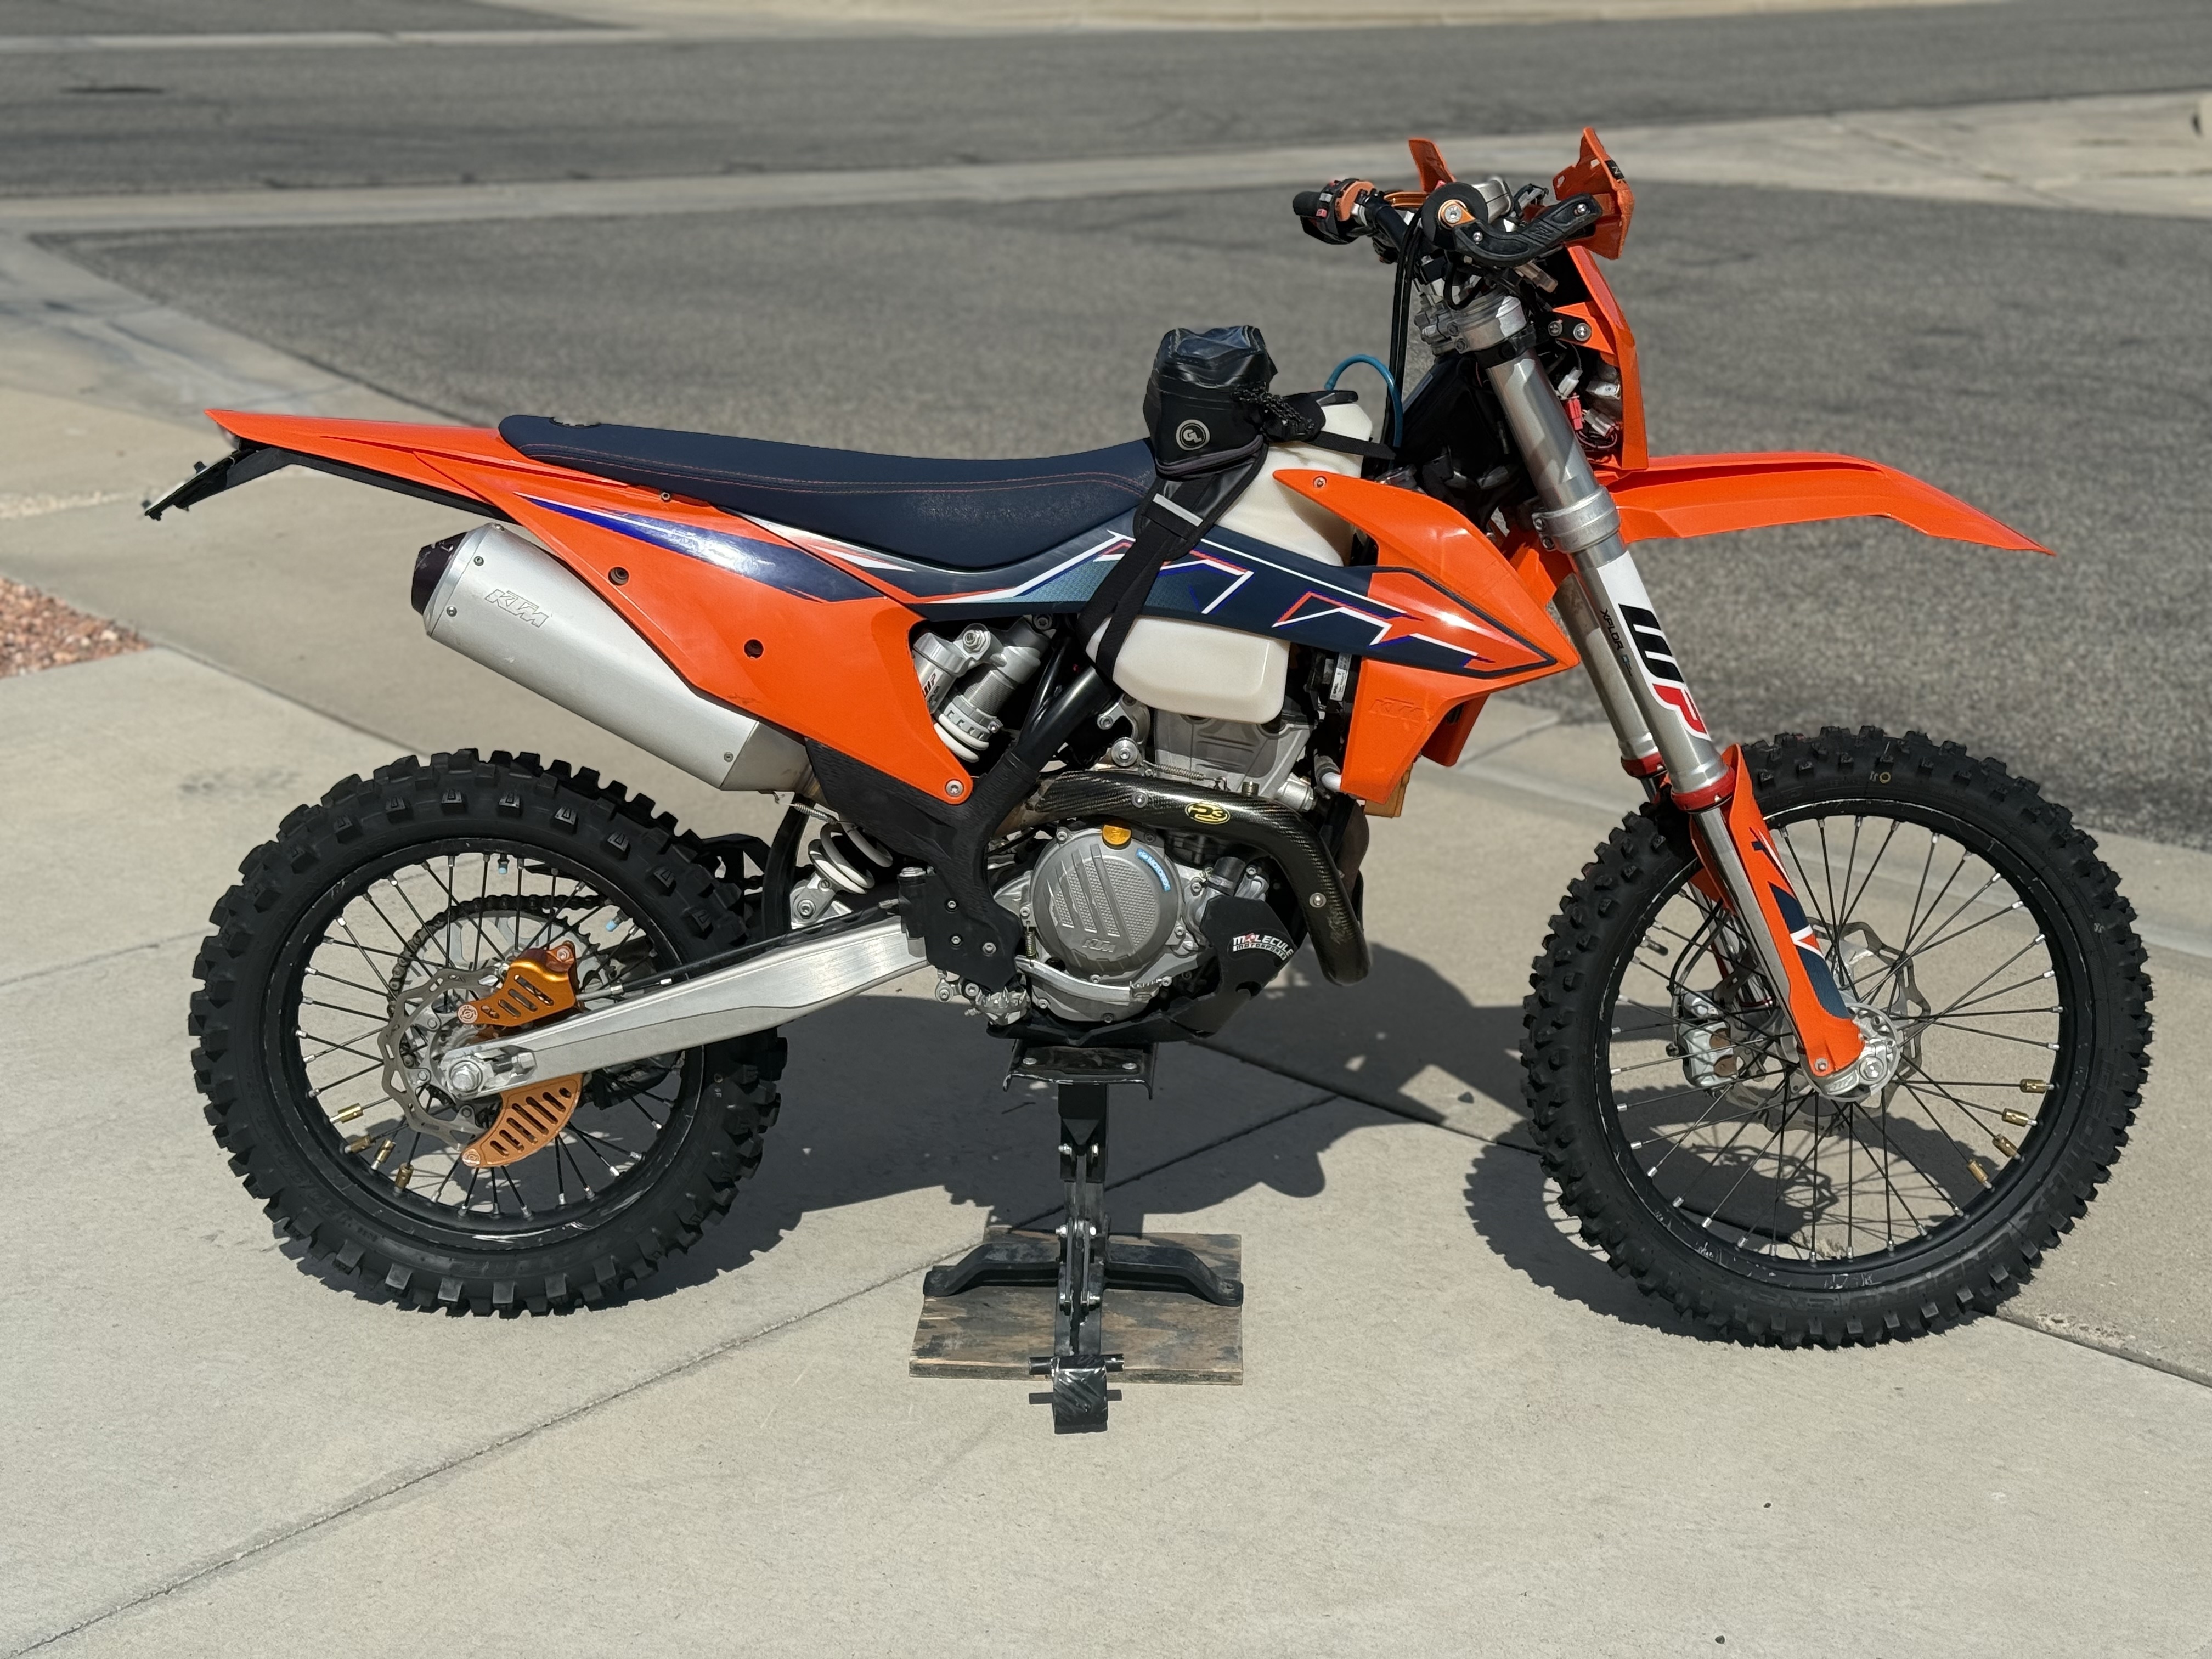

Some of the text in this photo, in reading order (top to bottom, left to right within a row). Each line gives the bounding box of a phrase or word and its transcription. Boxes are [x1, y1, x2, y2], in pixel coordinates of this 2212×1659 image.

[484, 589, 549, 628] KTM
[1600, 608, 1624, 650] XPLOR
[1618, 603, 1707, 735] WP
[1368, 697, 1425, 723] KTM
[1148, 856, 1171, 891] MOTOREX
[1082, 938, 1116, 953] KTM
